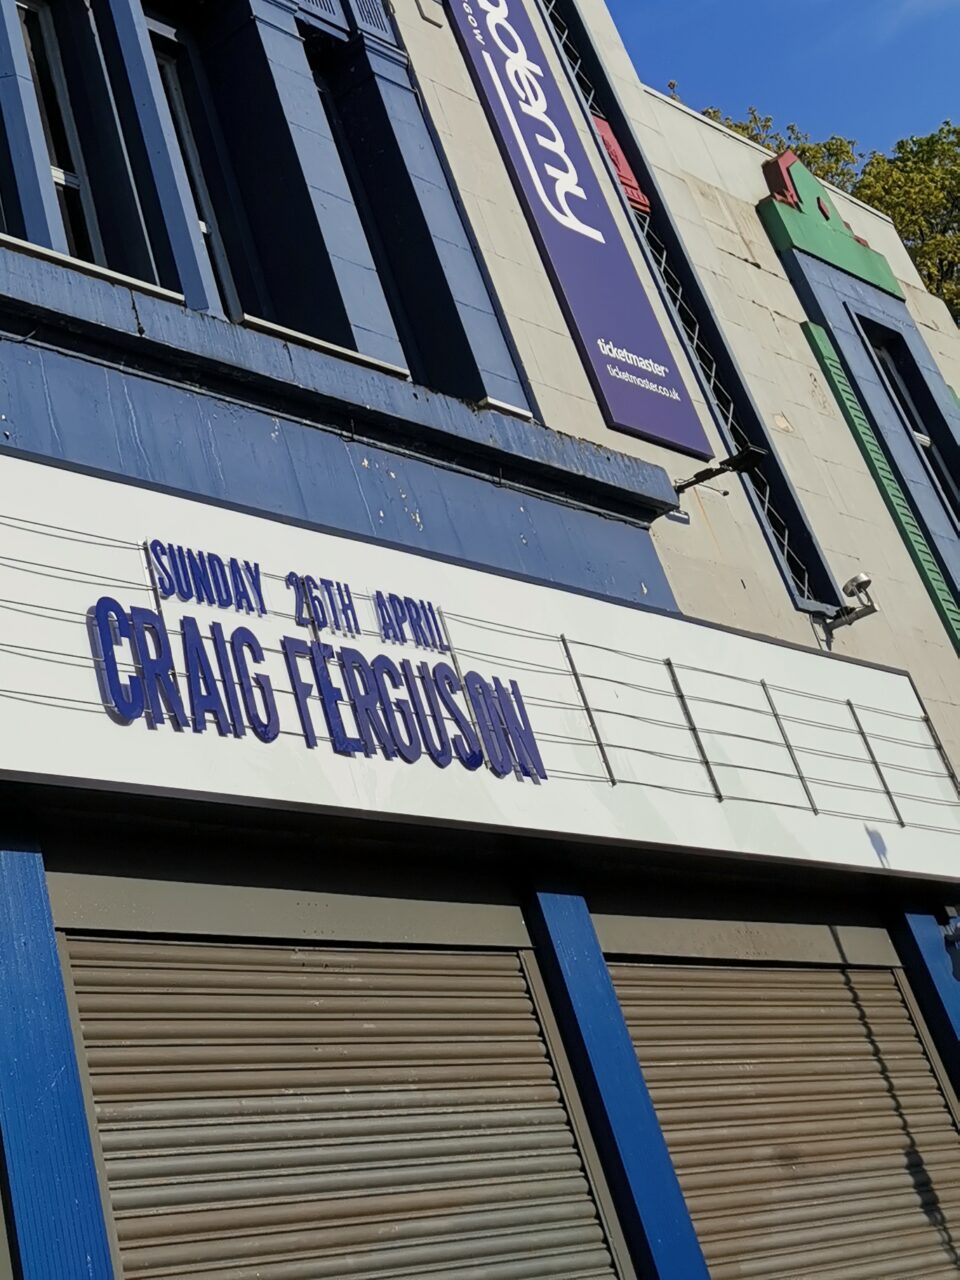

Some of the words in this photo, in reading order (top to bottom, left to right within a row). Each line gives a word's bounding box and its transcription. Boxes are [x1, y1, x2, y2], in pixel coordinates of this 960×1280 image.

[606, 363, 681, 402] ticketmaster.co.uk
[149, 538, 268, 618] SUNDAY
[286, 570, 361, 637] 26TH
[374, 589, 451, 654] APRIL
[87, 595, 281, 744] CRAIG
[280, 634, 548, 785] FERGUSON
